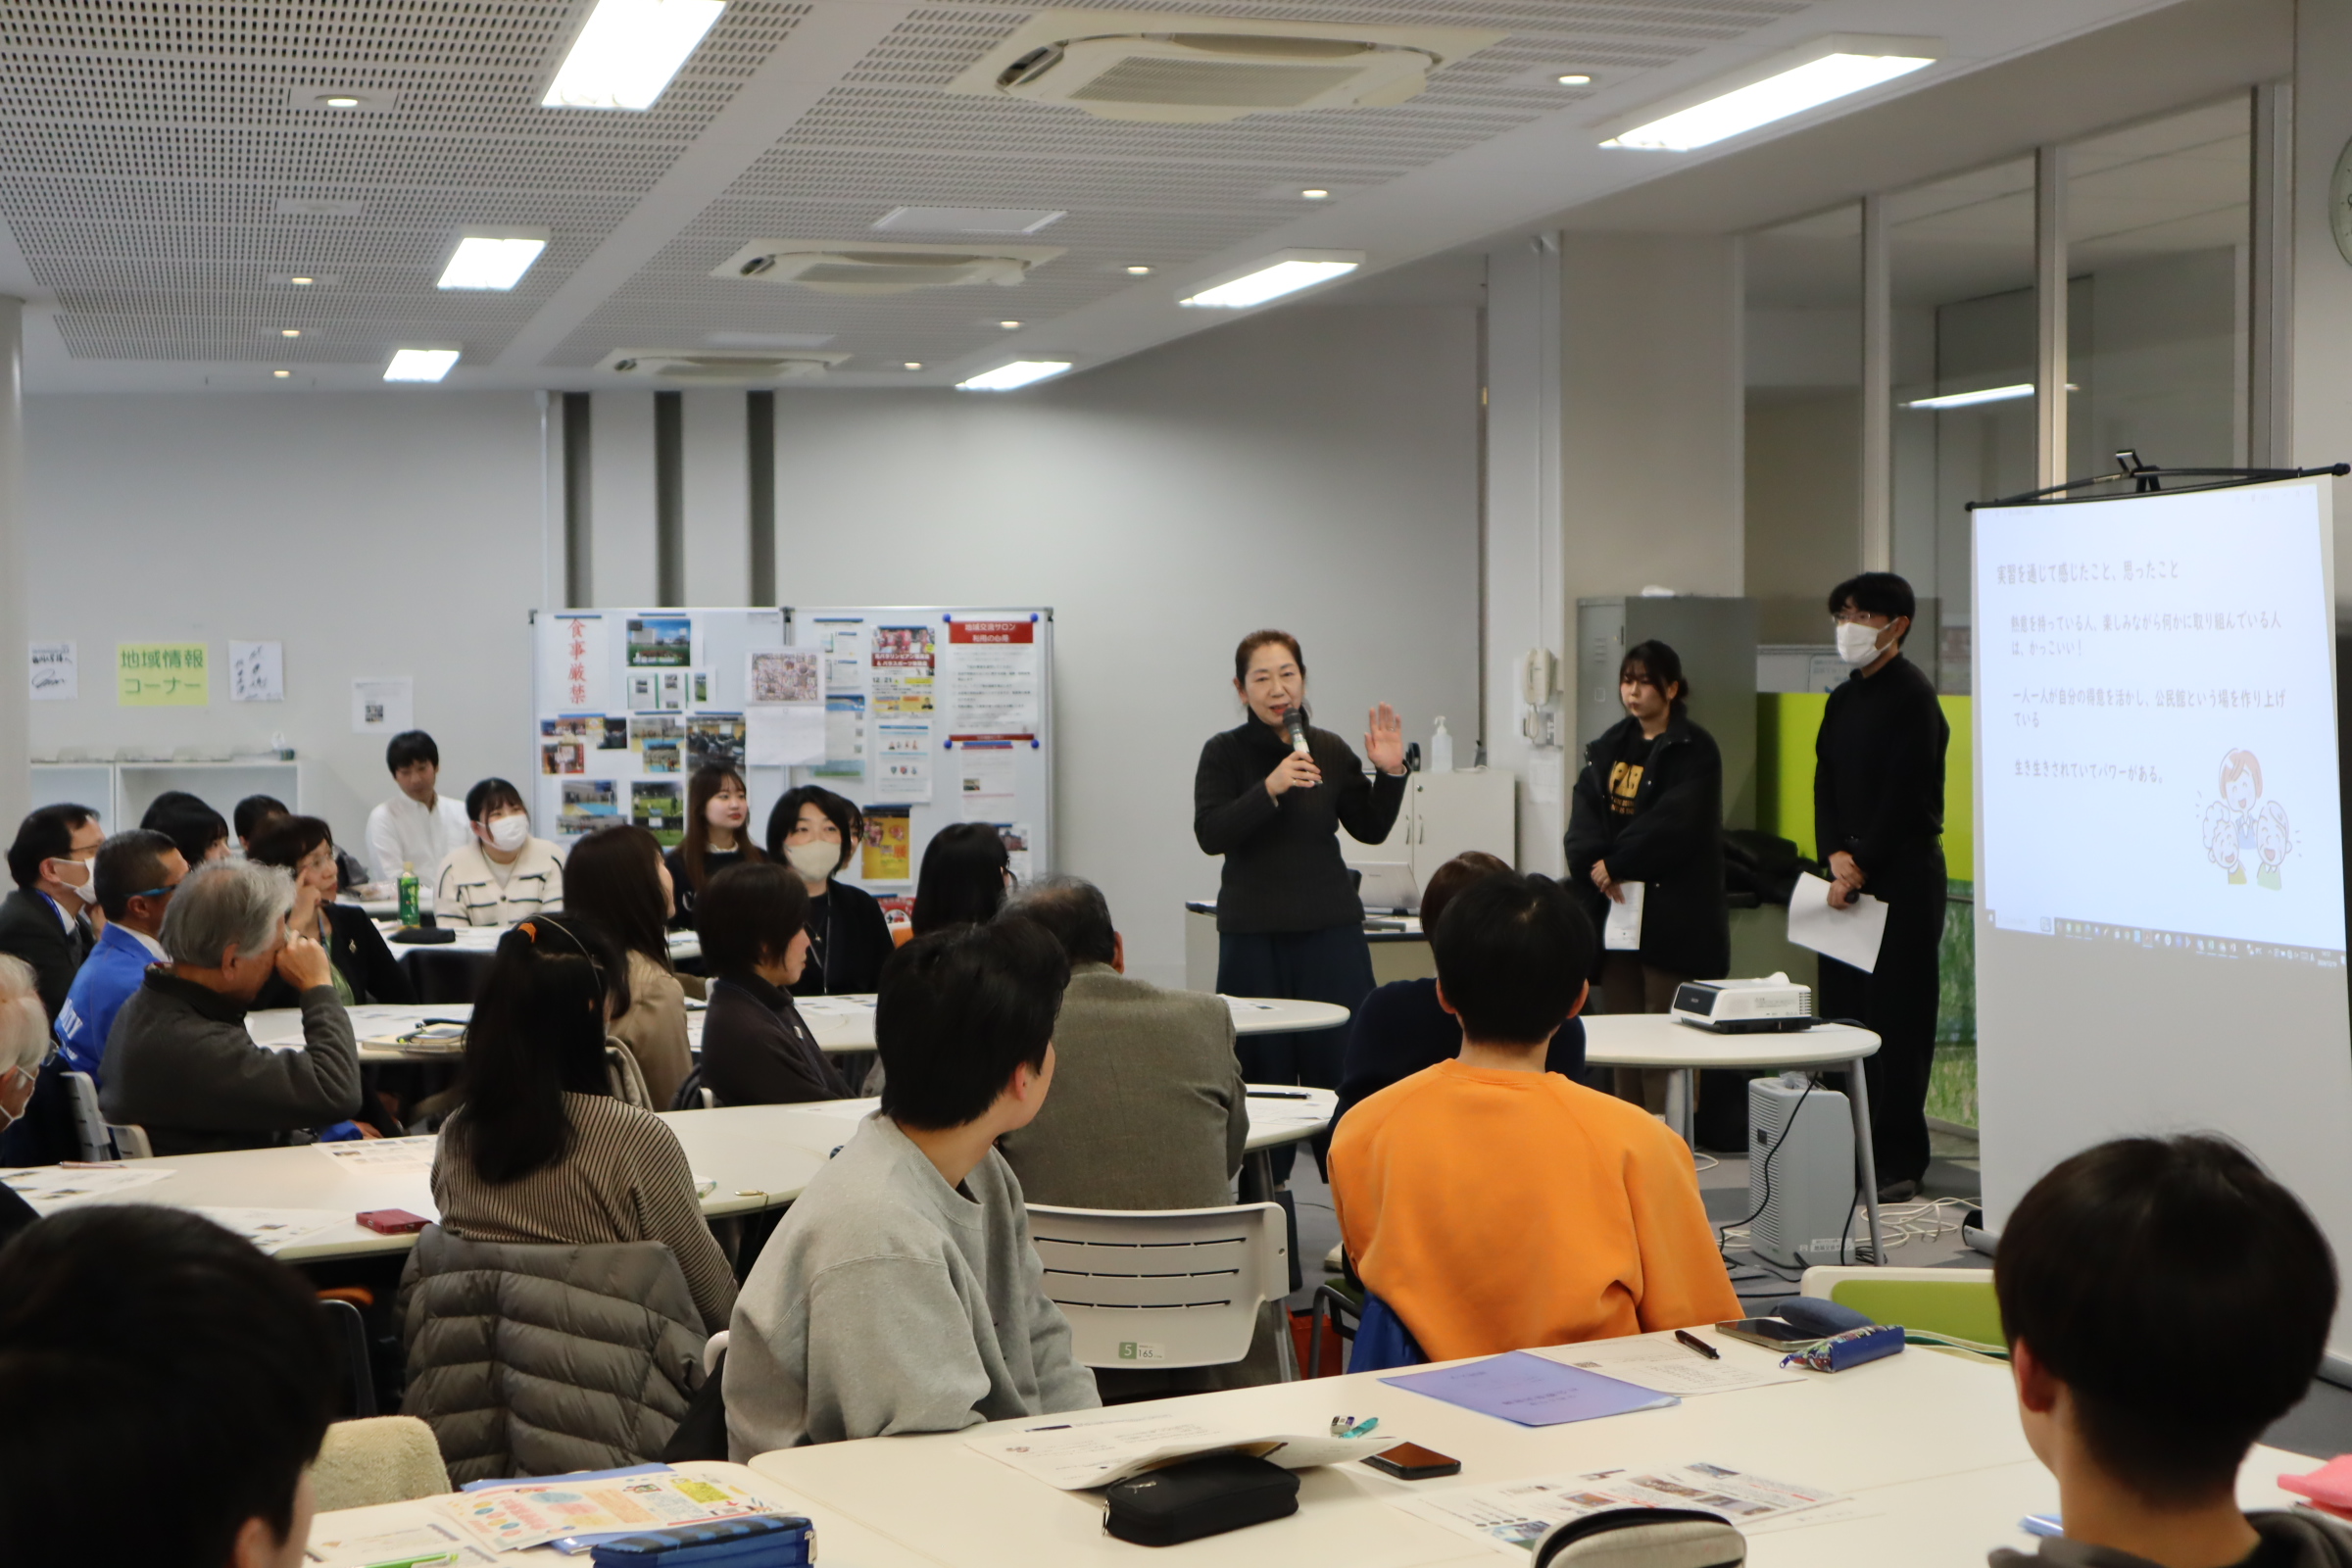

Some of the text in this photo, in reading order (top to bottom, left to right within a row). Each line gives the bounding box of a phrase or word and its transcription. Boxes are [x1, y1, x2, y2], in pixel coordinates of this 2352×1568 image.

[1996, 559, 2180, 585] 実習を通じて感じたこと、思ったこと
[2011, 610, 2282, 633] 熱意を持っている人、楽しみながら何かに取り組んでいる人
[121, 649, 204, 669] 地域情報
[567, 618, 587, 705] 食事厳禁
[123, 676, 202, 695] コーナー
[2013, 686, 2286, 709] 一人一人が自分の得意を活かし、公民館という場を作り上げ
[2014, 711, 2040, 728] ている
[2014, 758, 2163, 784] 生き生きされていてパワーがある。
[1124, 1344, 1153, 1358] 5 165
